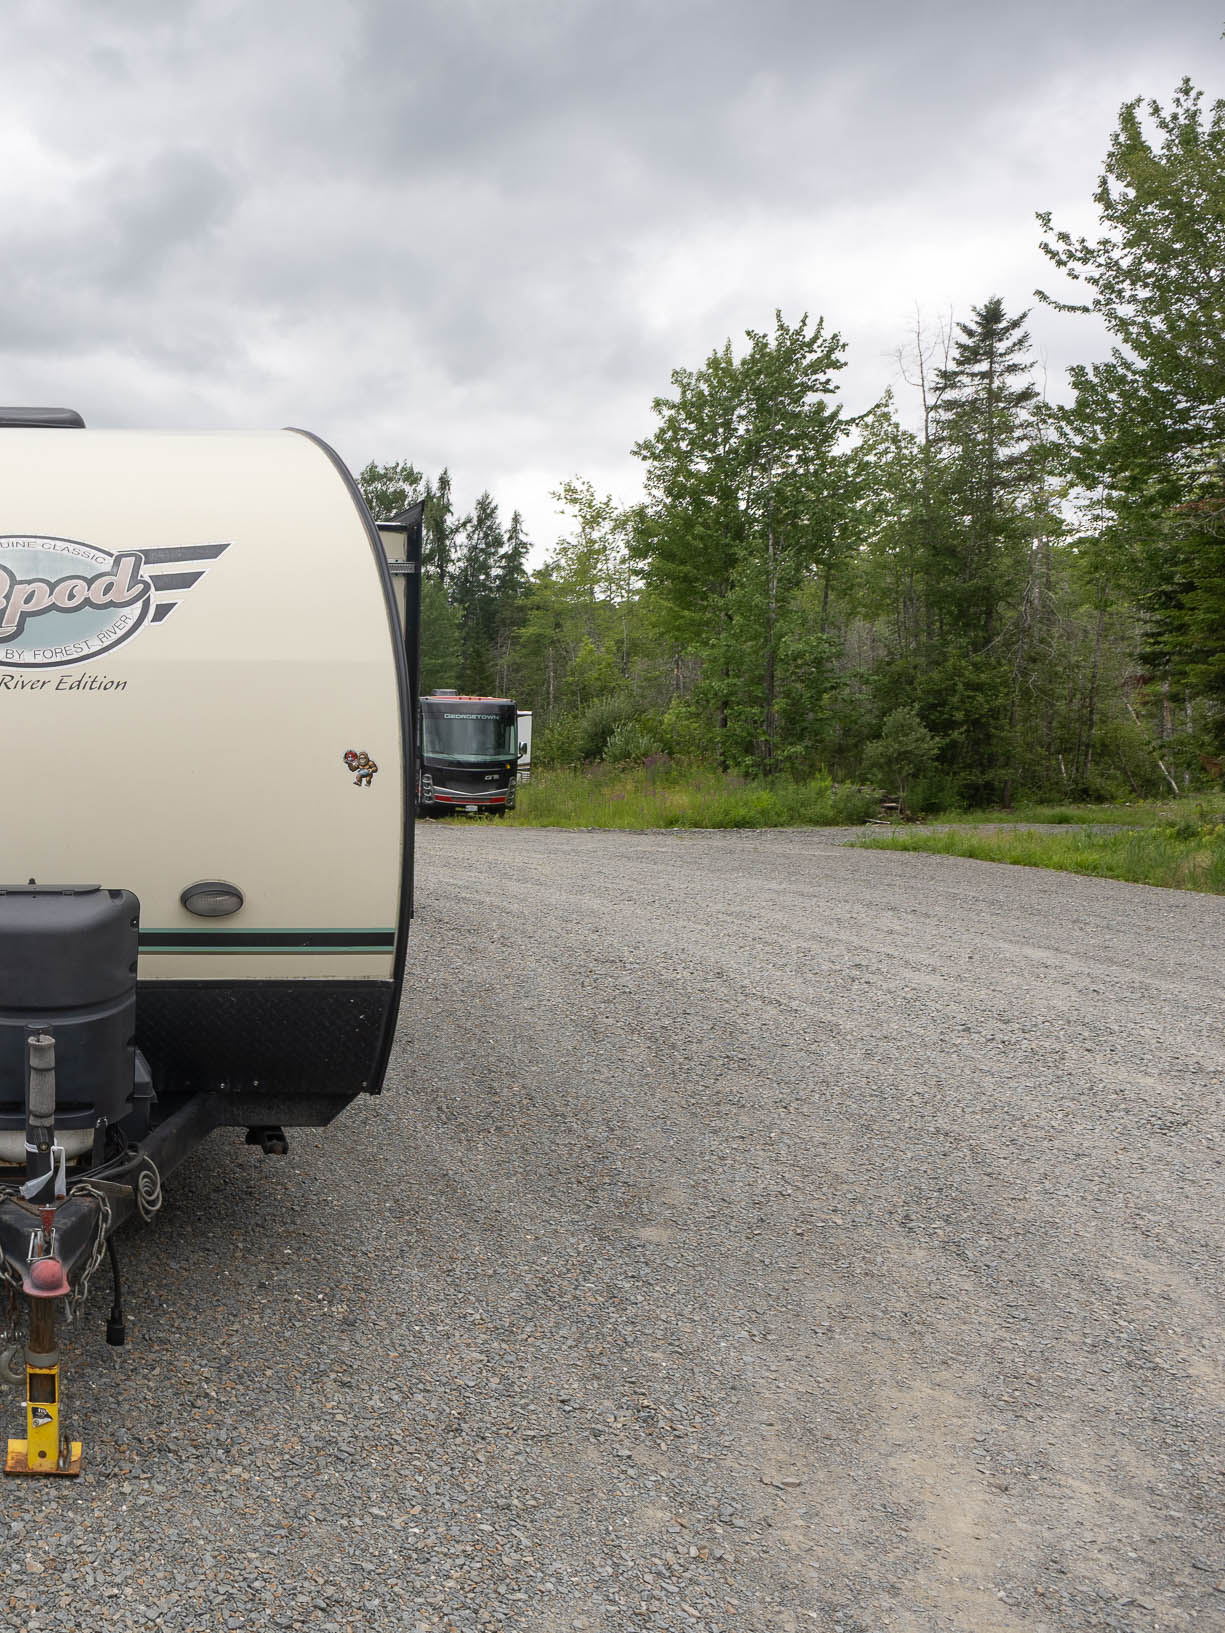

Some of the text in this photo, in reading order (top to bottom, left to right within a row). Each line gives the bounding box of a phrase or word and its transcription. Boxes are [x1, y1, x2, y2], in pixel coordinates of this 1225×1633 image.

[41, 542, 106, 565] CLASSIC
[4, 614, 133, 660] BY FOREST RIVER
[55, 671, 128, 691] Edition
